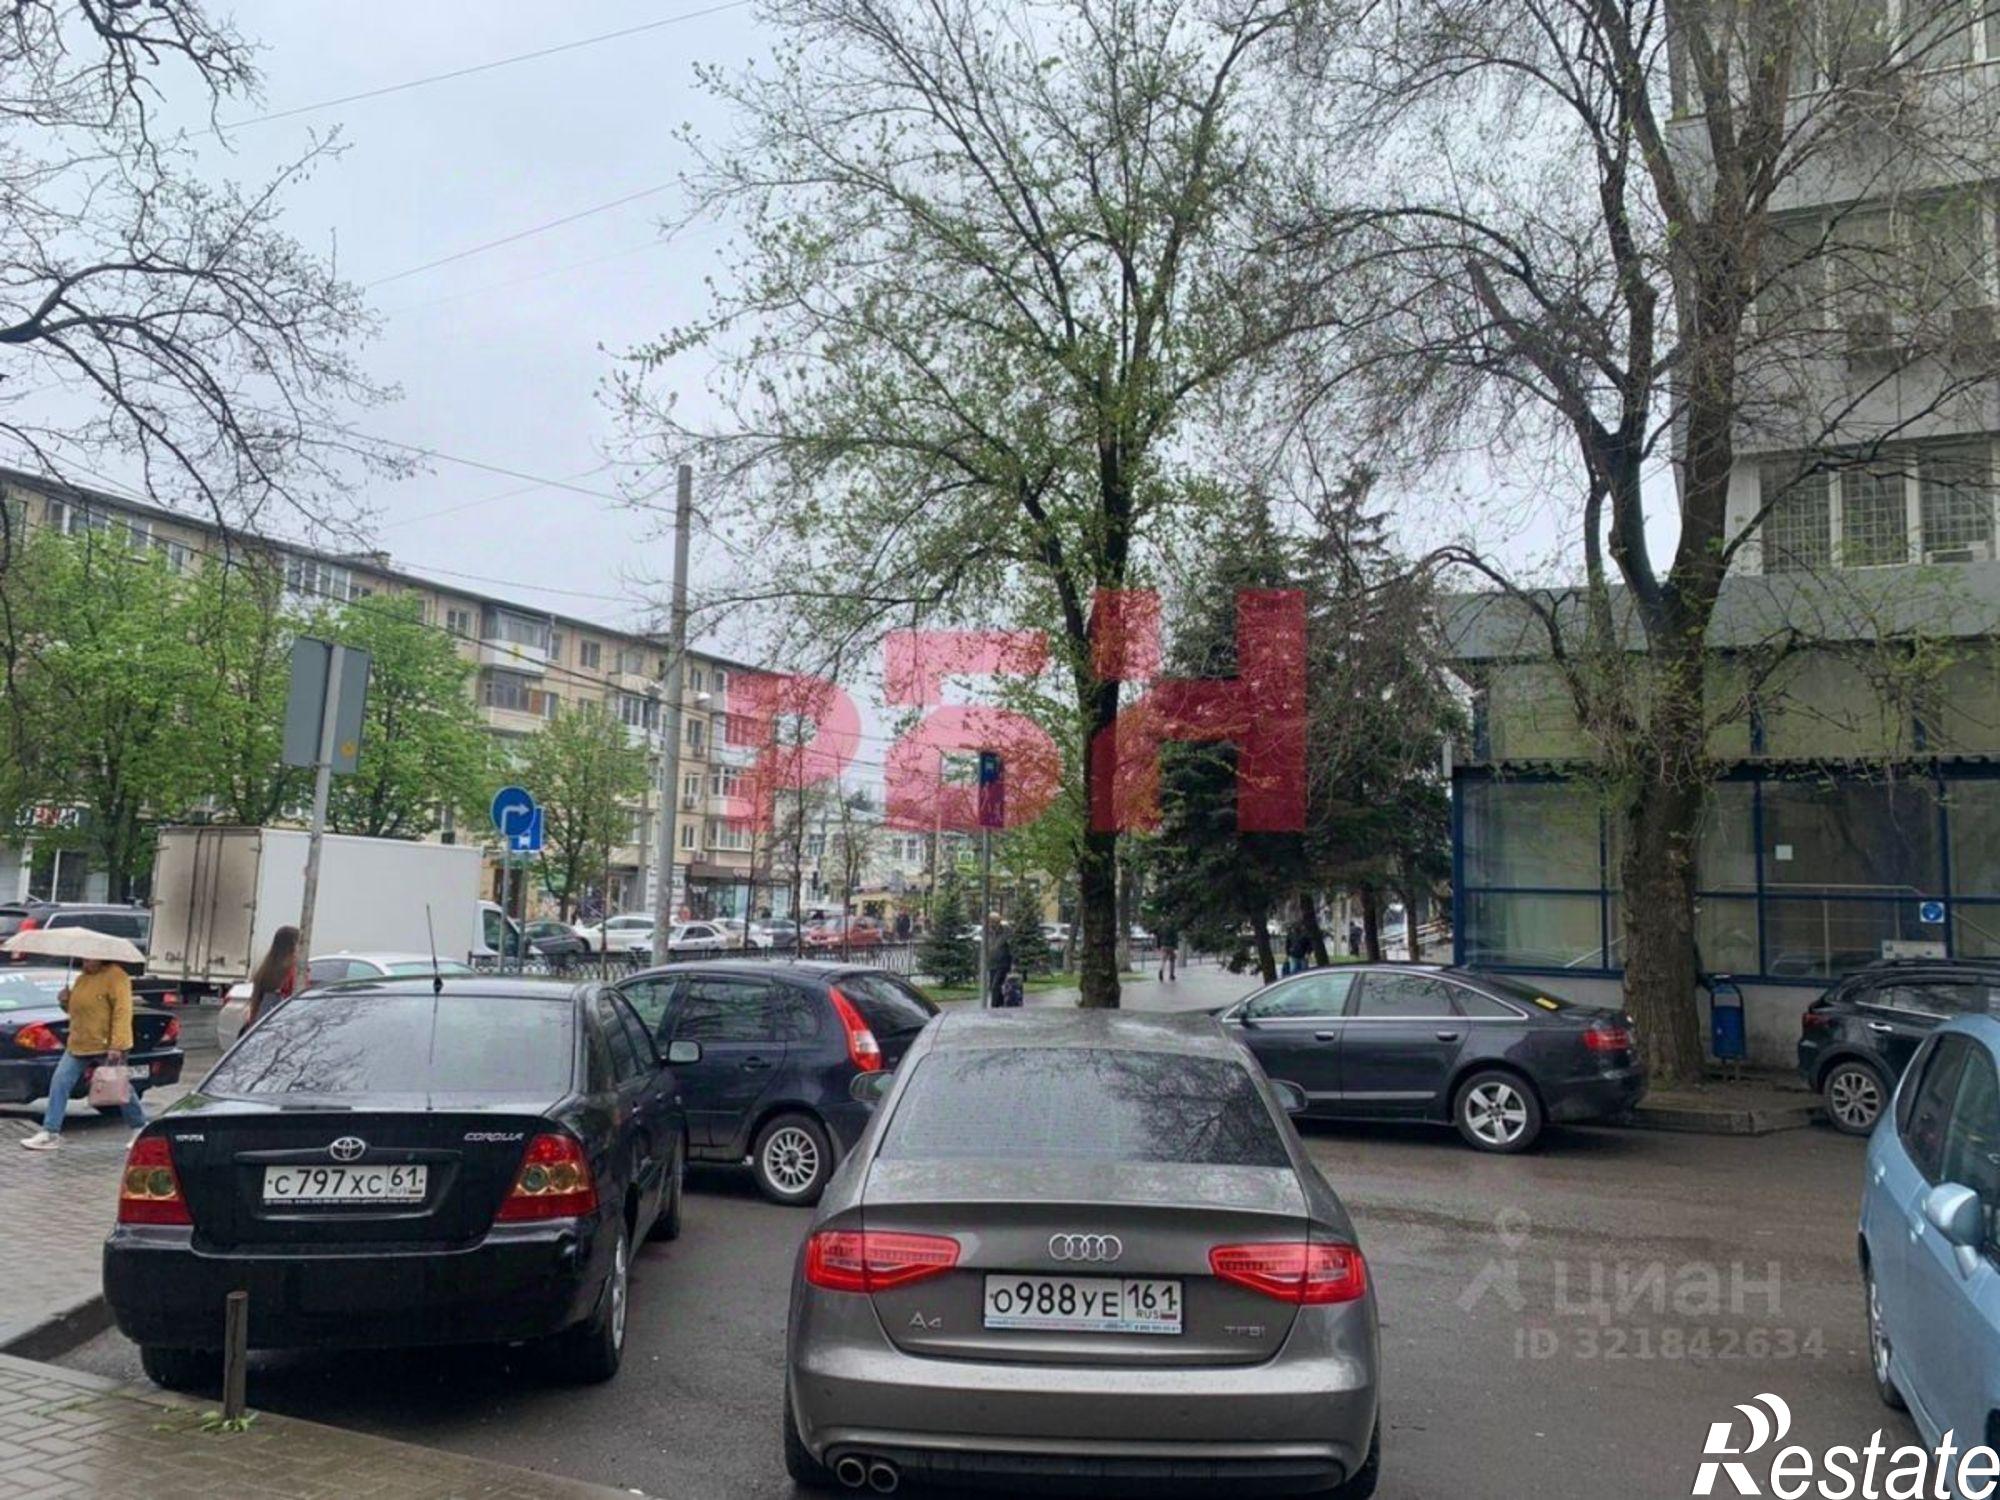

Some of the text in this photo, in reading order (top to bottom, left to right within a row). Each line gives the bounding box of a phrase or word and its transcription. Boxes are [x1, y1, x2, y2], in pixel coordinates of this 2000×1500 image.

[391, 1167, 418, 1187] 61
[1127, 1283, 1177, 1311] 161
[1136, 1308, 1160, 1320] RUS
